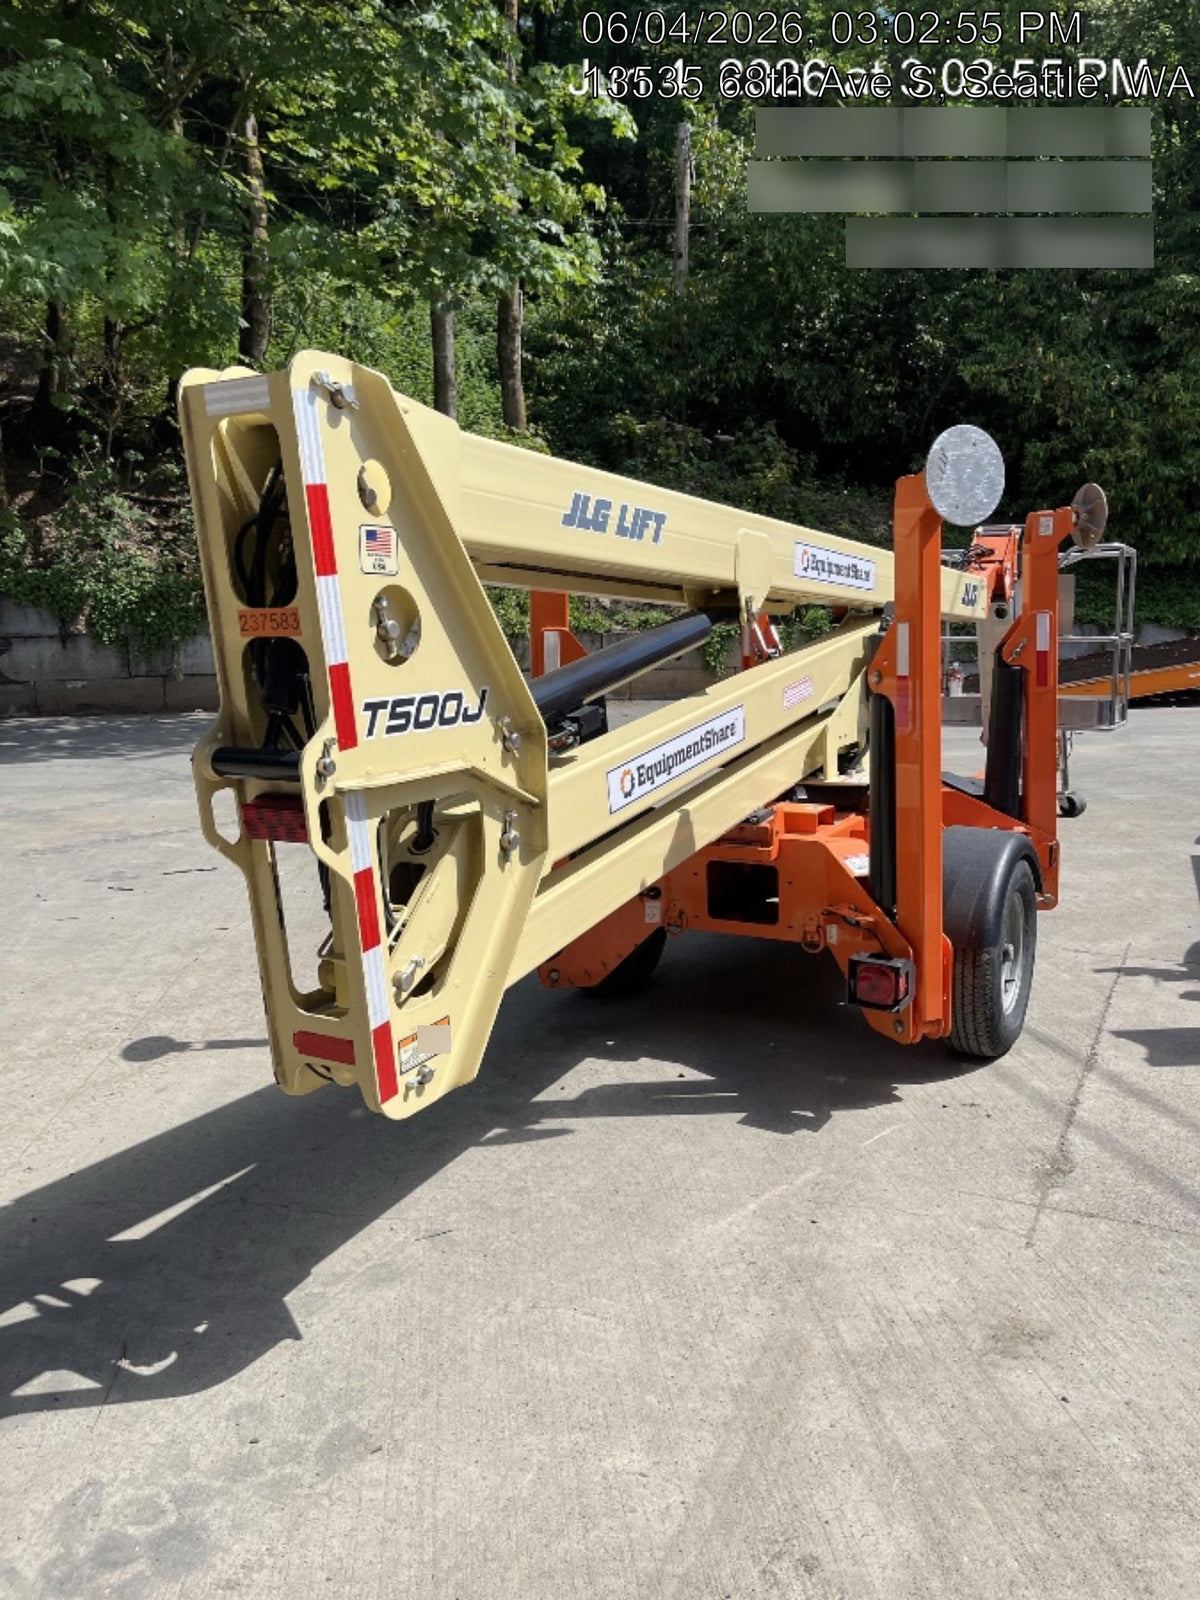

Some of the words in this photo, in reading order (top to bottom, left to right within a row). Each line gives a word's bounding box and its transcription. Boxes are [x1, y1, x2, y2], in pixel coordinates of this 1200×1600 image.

[561, 492, 612, 533] JLG
[615, 504, 667, 544] LIFT
[239, 612, 300, 632] 237583
[362, 688, 488, 738] T500J
[636, 721, 736, 787] EquipmentShare
